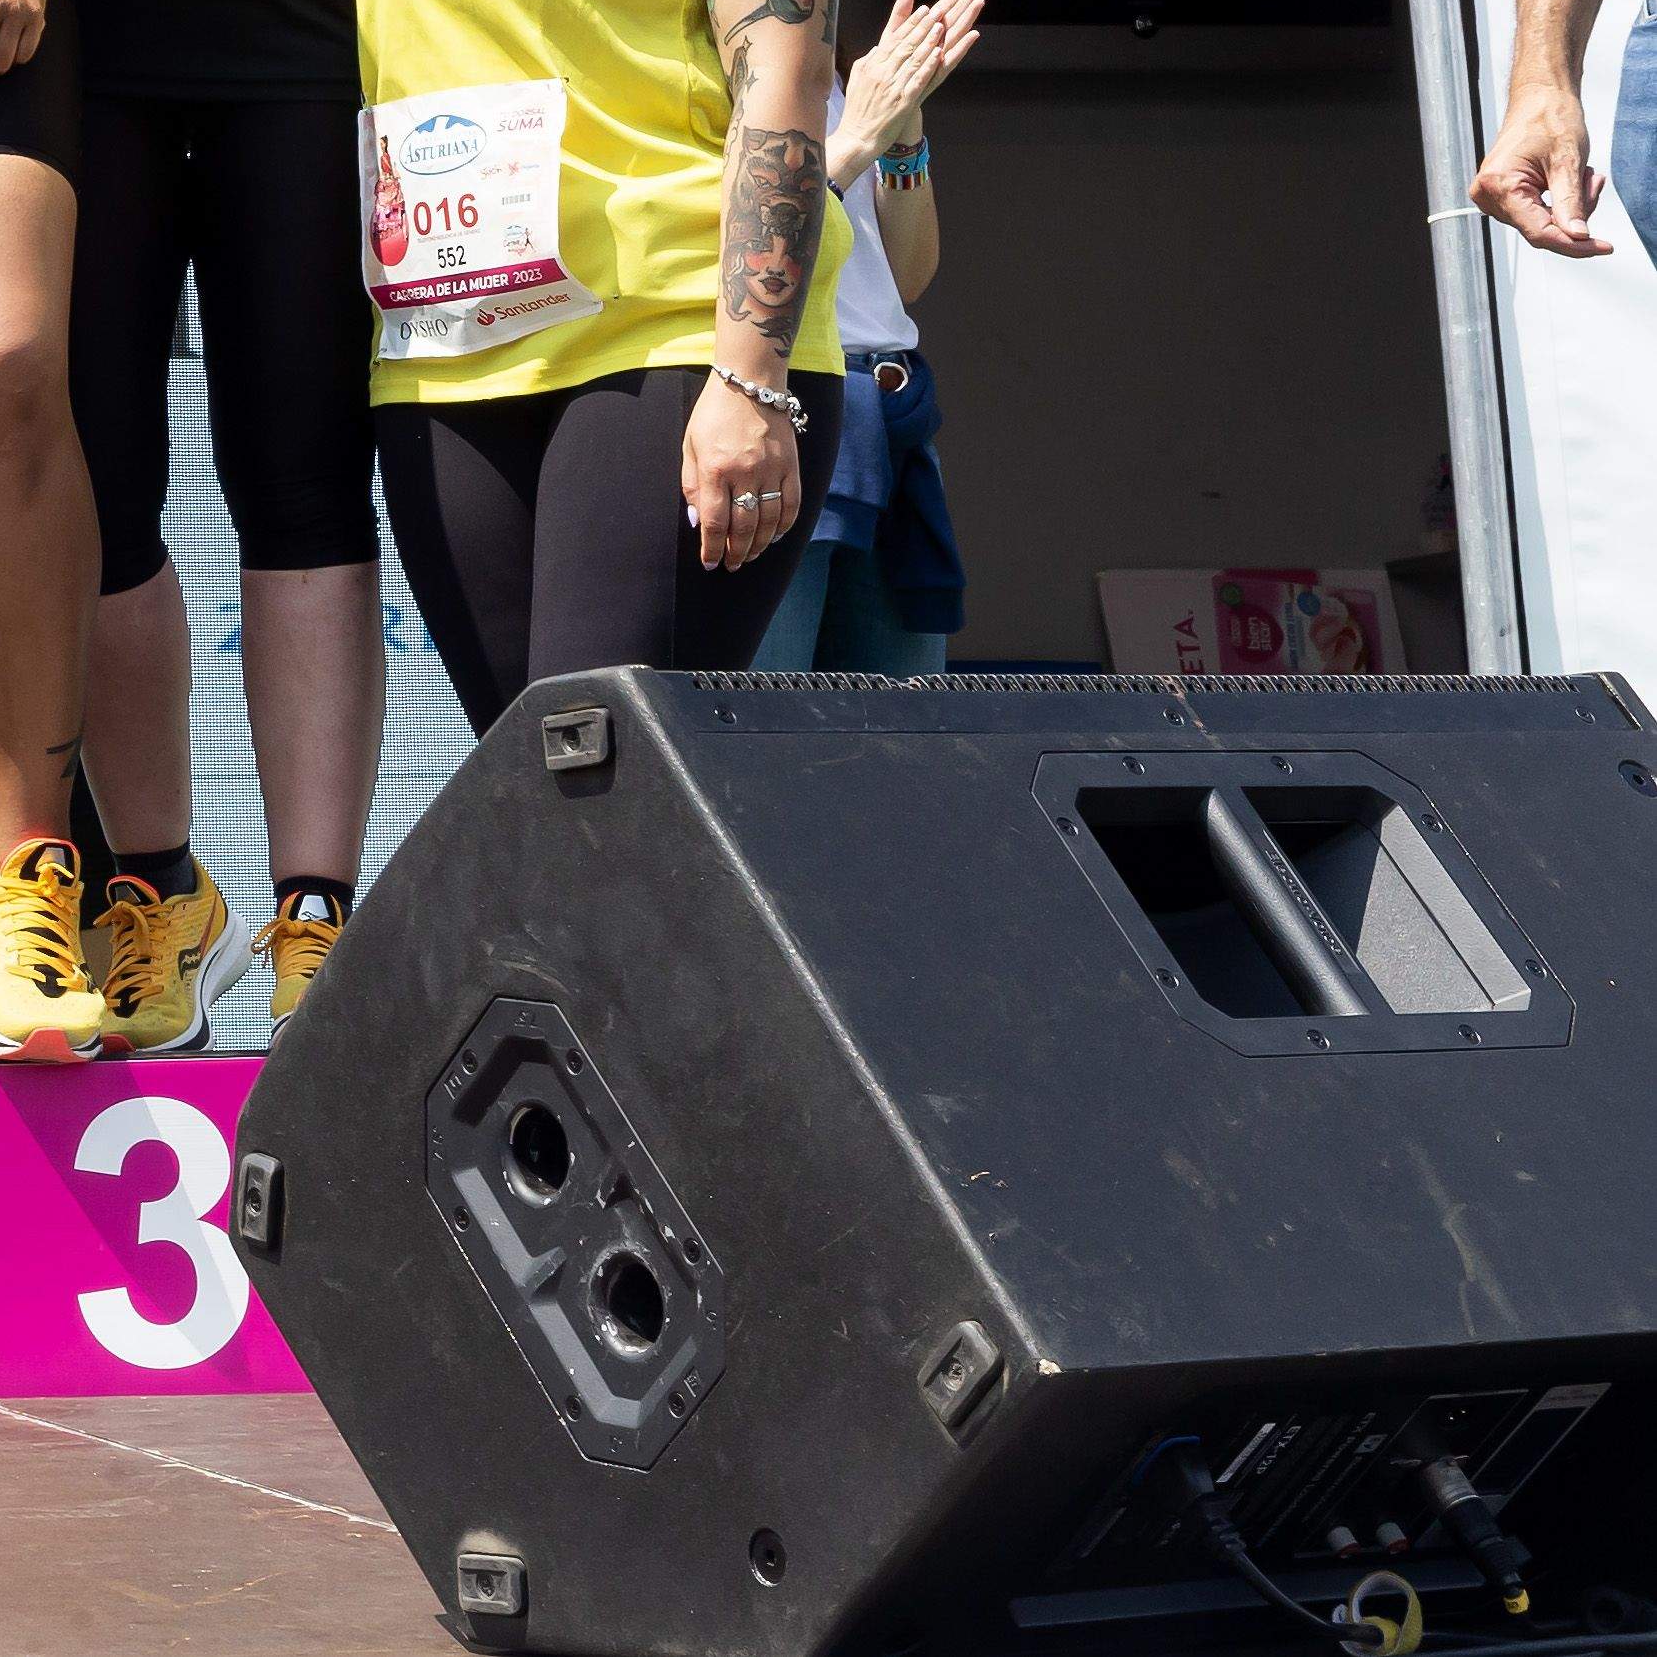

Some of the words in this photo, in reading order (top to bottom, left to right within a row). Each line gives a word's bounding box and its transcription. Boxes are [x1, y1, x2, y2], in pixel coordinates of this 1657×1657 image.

[496, 117, 543, 132] SUMA
[405, 138, 479, 164] ASTURIANA
[413, 194, 479, 236] 016
[437, 245, 466, 268] 552
[389, 285, 435, 302] CARRERA
[436, 282, 452, 295] DE
[452, 280, 468, 294] LA
[469, 275, 509, 291] MUJER
[512, 268, 543, 284] 2023
[495, 293, 571, 321] Santander
[400, 318, 448, 340] OYSHO
[73, 1096, 247, 1370] 3
